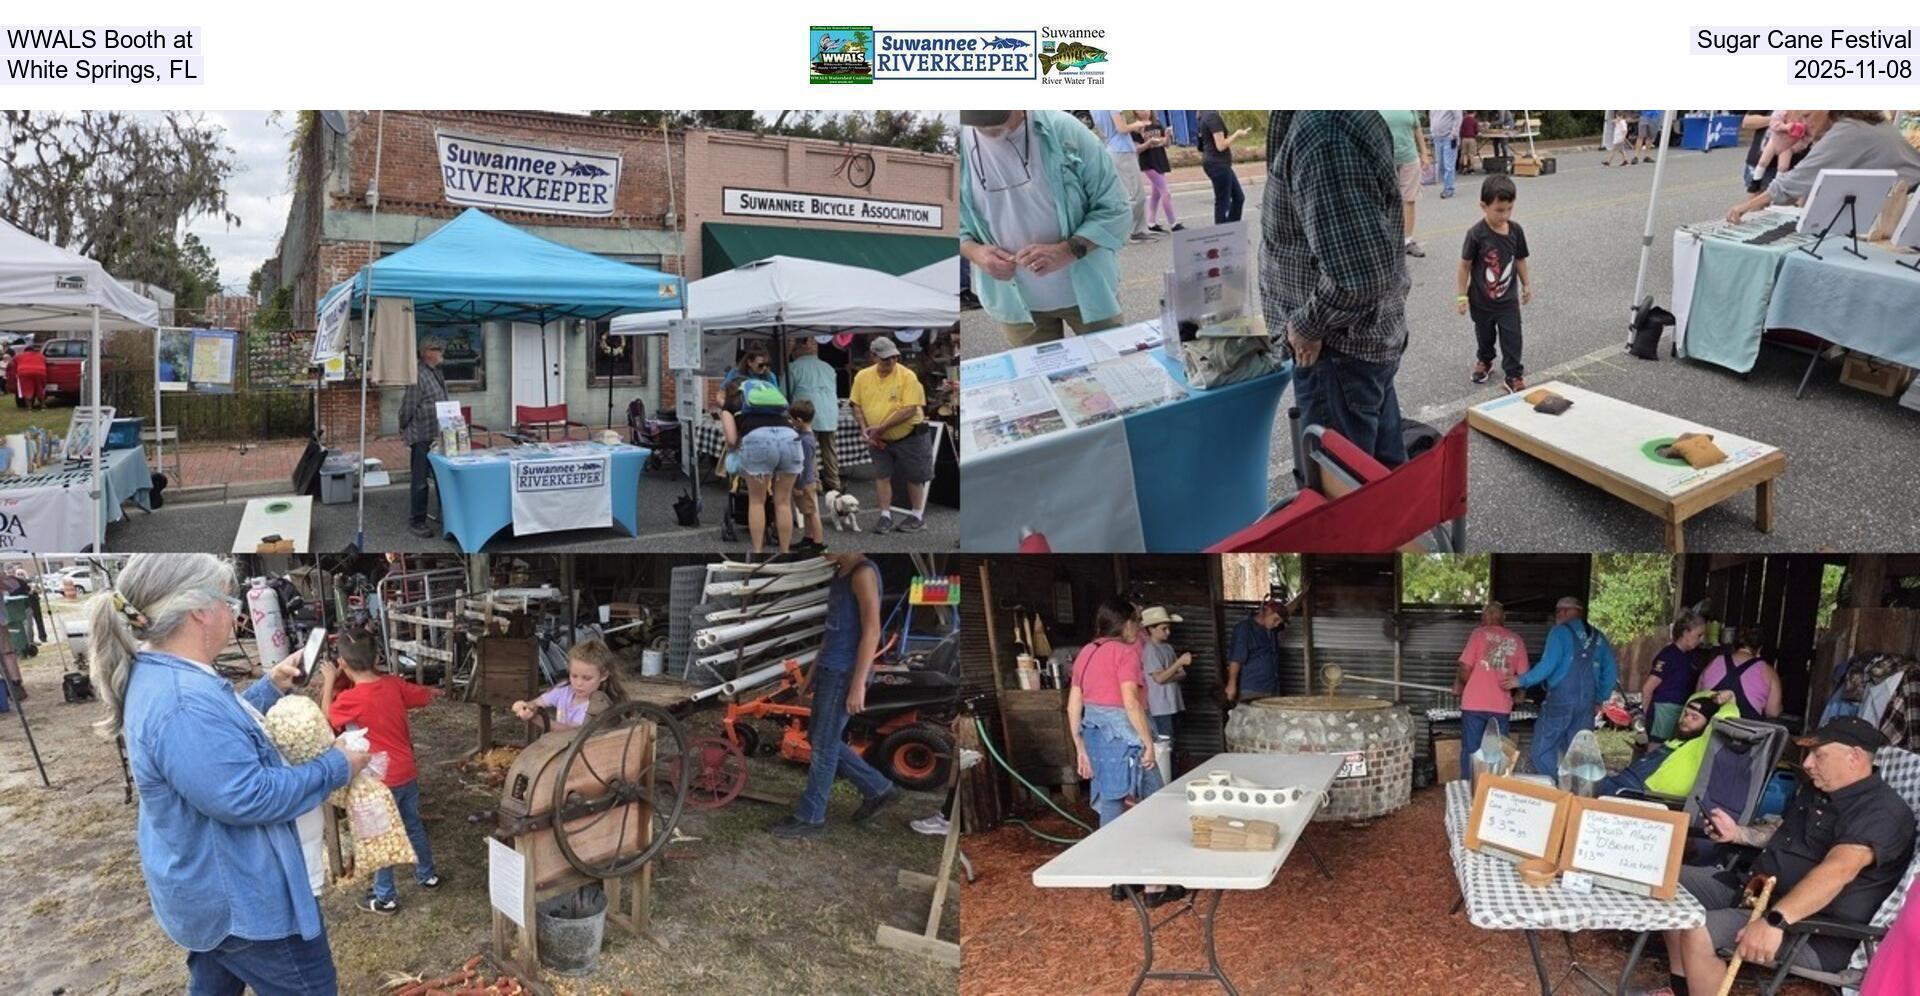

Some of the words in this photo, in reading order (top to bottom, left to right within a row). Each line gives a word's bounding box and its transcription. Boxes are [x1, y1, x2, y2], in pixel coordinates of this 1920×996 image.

[447, 143, 557, 175] Suwannee
[443, 165, 608, 204] RIVERKEEPER
[740, 193, 805, 213] SUWANNEE
[811, 198, 855, 216] BICYCLE
[861, 203, 929, 222] ASSOCIATION
[519, 472, 601, 488] RIVERKEEPER
[522, 464, 575, 475] Suwannee
